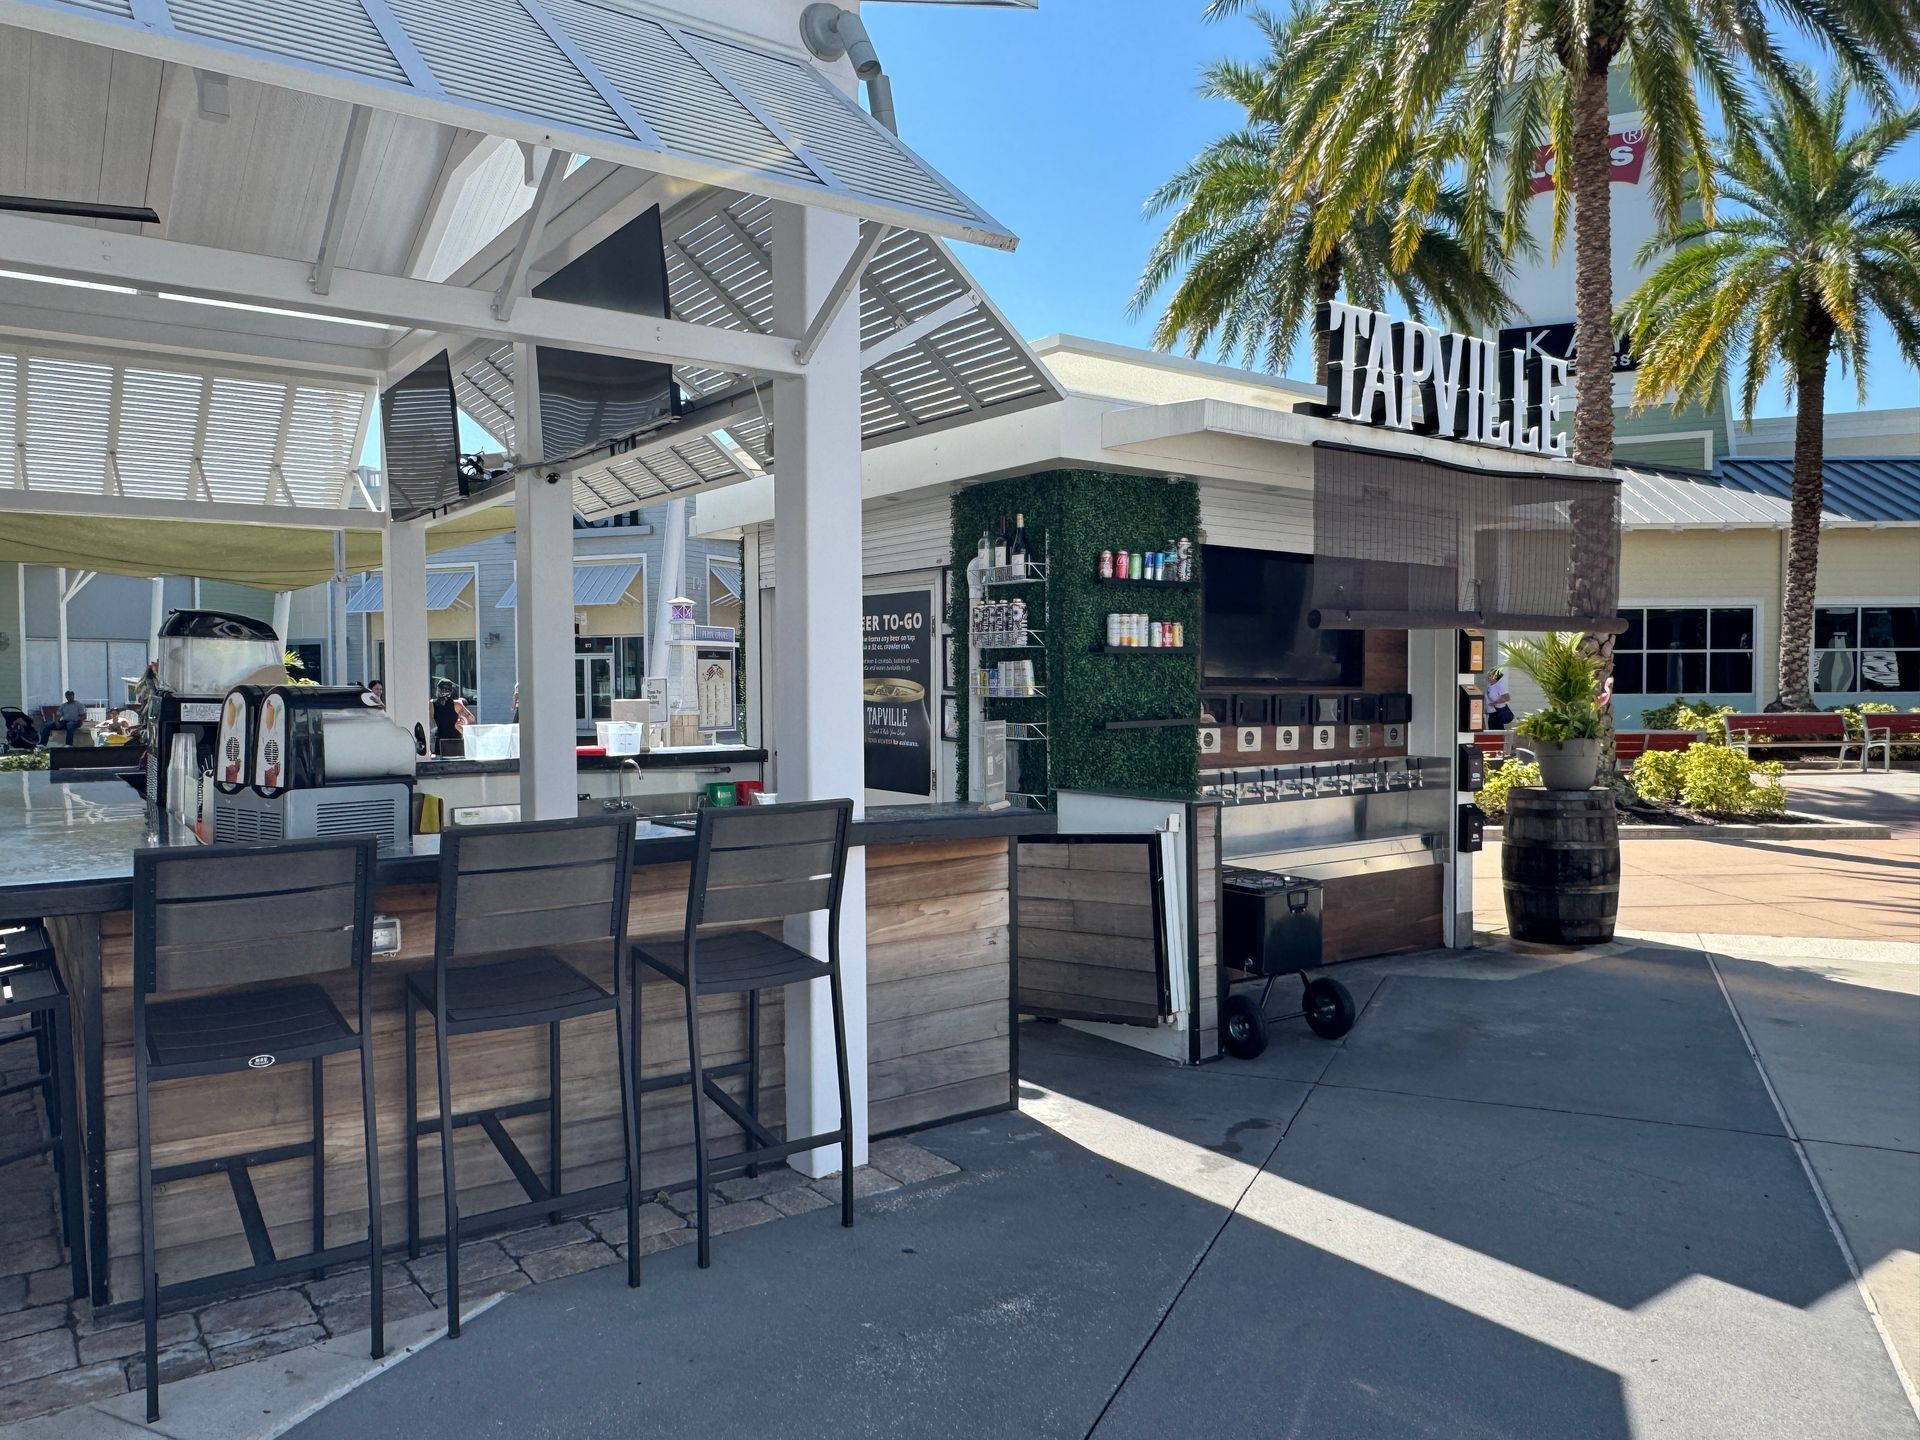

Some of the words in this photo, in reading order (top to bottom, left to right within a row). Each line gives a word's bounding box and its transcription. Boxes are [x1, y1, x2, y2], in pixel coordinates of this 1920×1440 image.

[1326, 300, 1568, 457] TAPVILLE
[883, 612, 922, 631] TO-GO
[867, 707, 907, 727] TAPVILLE
